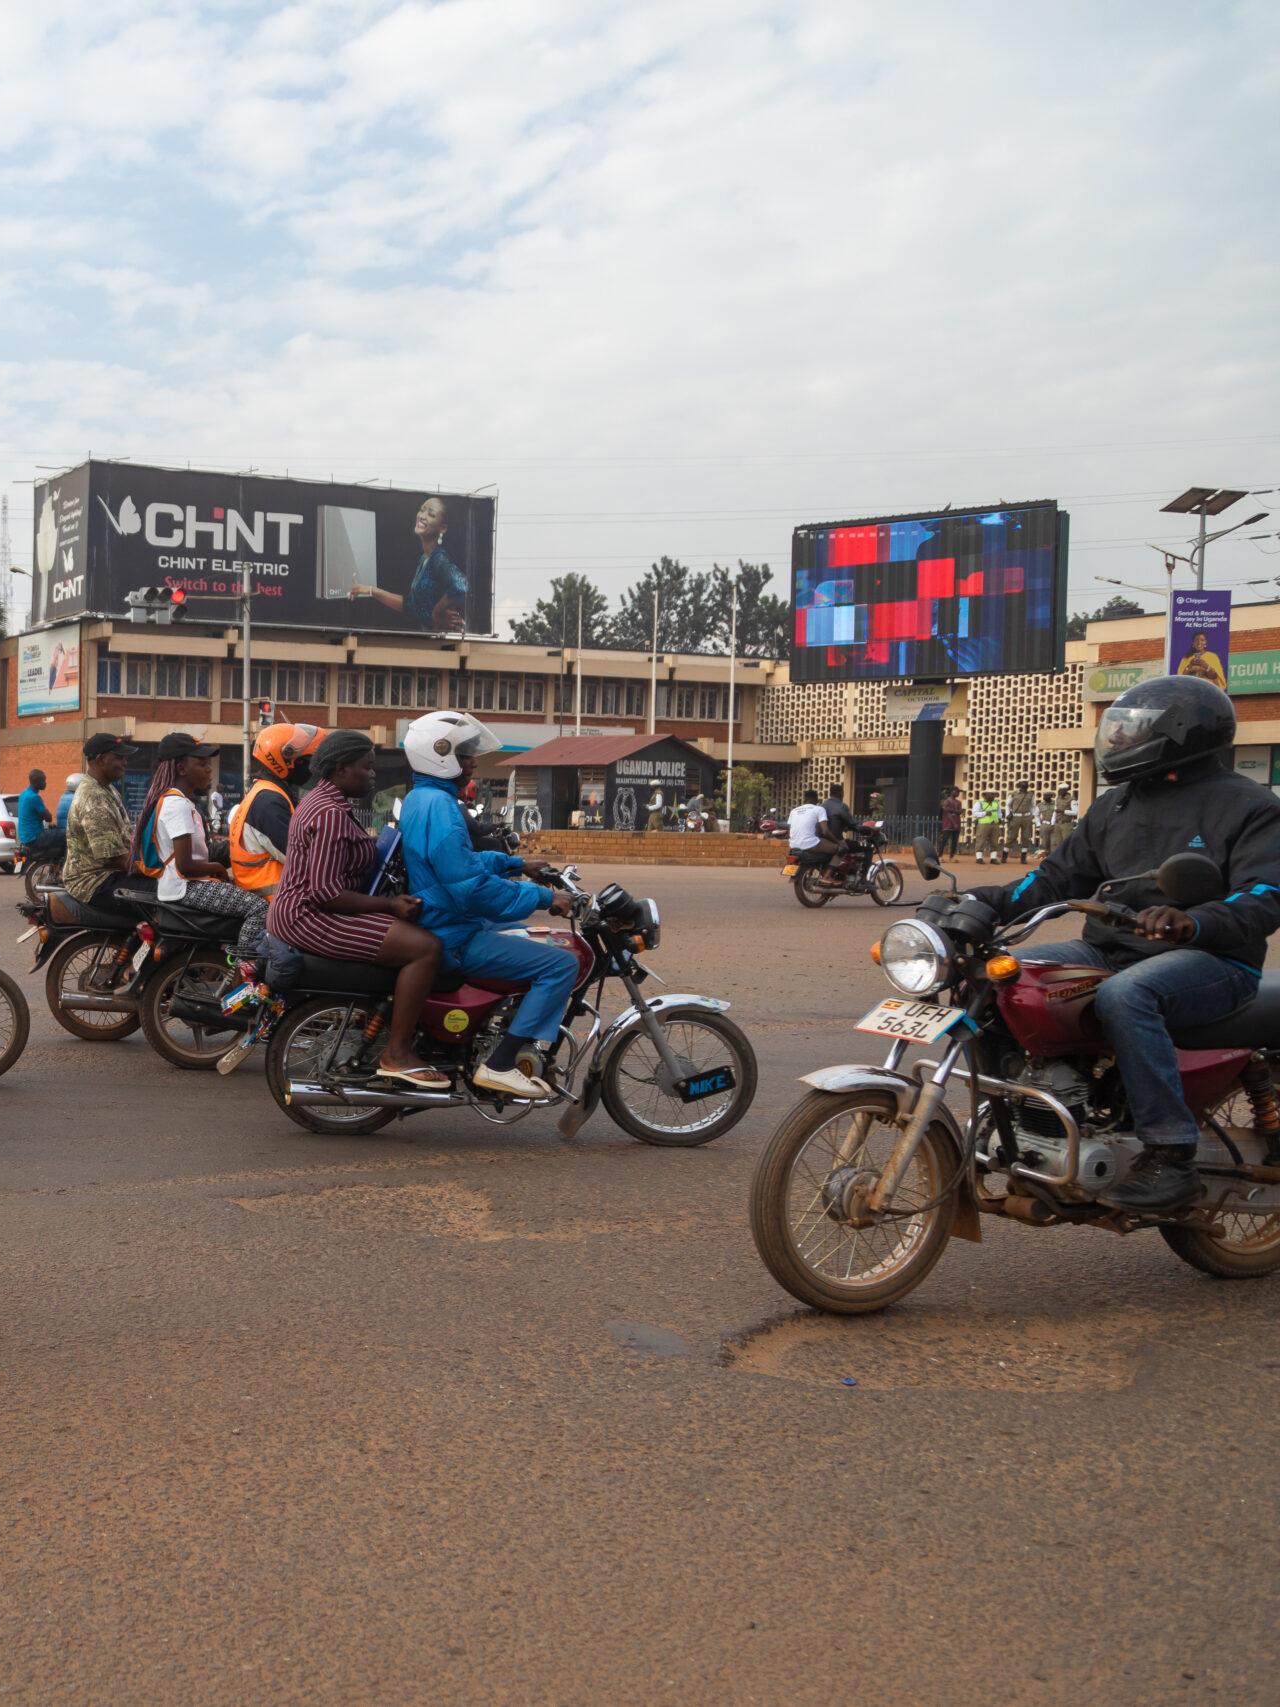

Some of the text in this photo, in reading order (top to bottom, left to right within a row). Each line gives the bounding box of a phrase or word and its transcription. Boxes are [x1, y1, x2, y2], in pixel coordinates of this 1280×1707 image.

[158, 555, 207, 571] CHINT
[164, 575, 208, 592] Switch
[212, 580, 227, 592] to
[256, 582, 283, 597] best
[1228, 663, 1268, 677] TGUM
[616, 759, 686, 778] UGANDA POLICE
[903, 1003, 952, 1023] UFH
[876, 1016, 929, 1039] 563L
